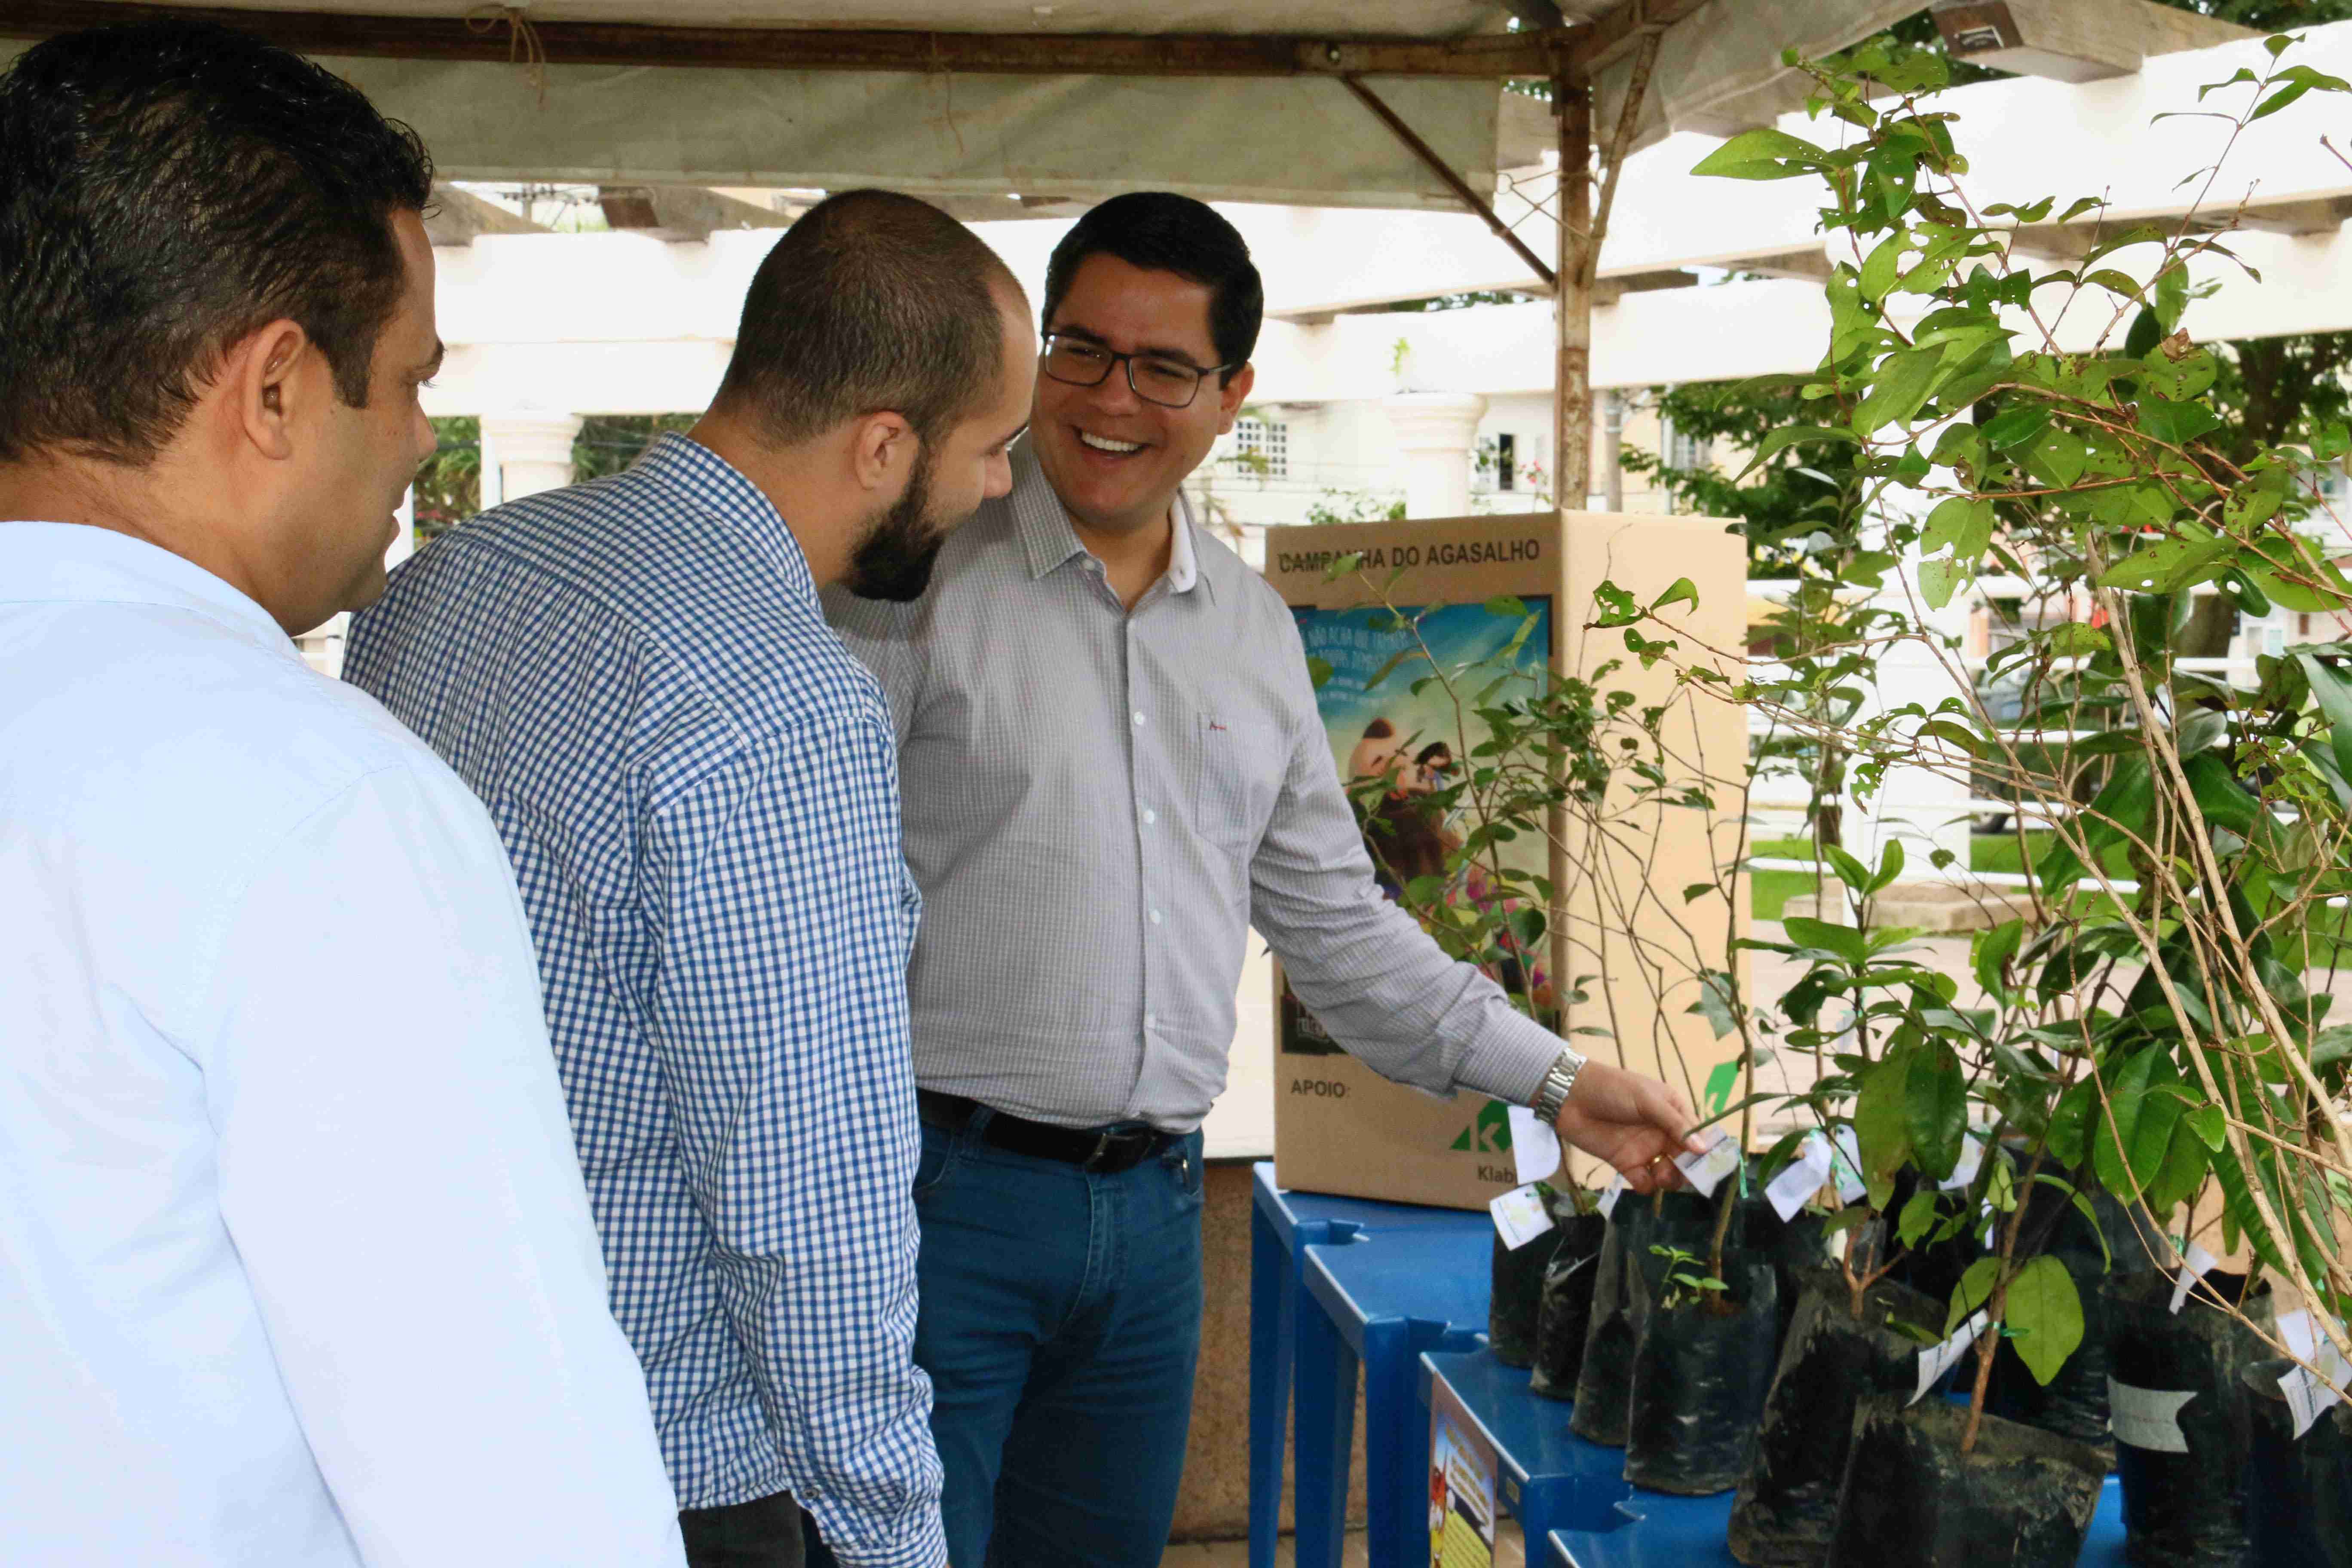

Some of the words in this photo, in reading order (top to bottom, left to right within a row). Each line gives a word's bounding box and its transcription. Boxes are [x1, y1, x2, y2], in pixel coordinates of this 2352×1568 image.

[1279, 548, 1385, 573] CAMPHA
[1392, 546, 1421, 567] DO
[1426, 538, 1540, 566] AGASALHO
